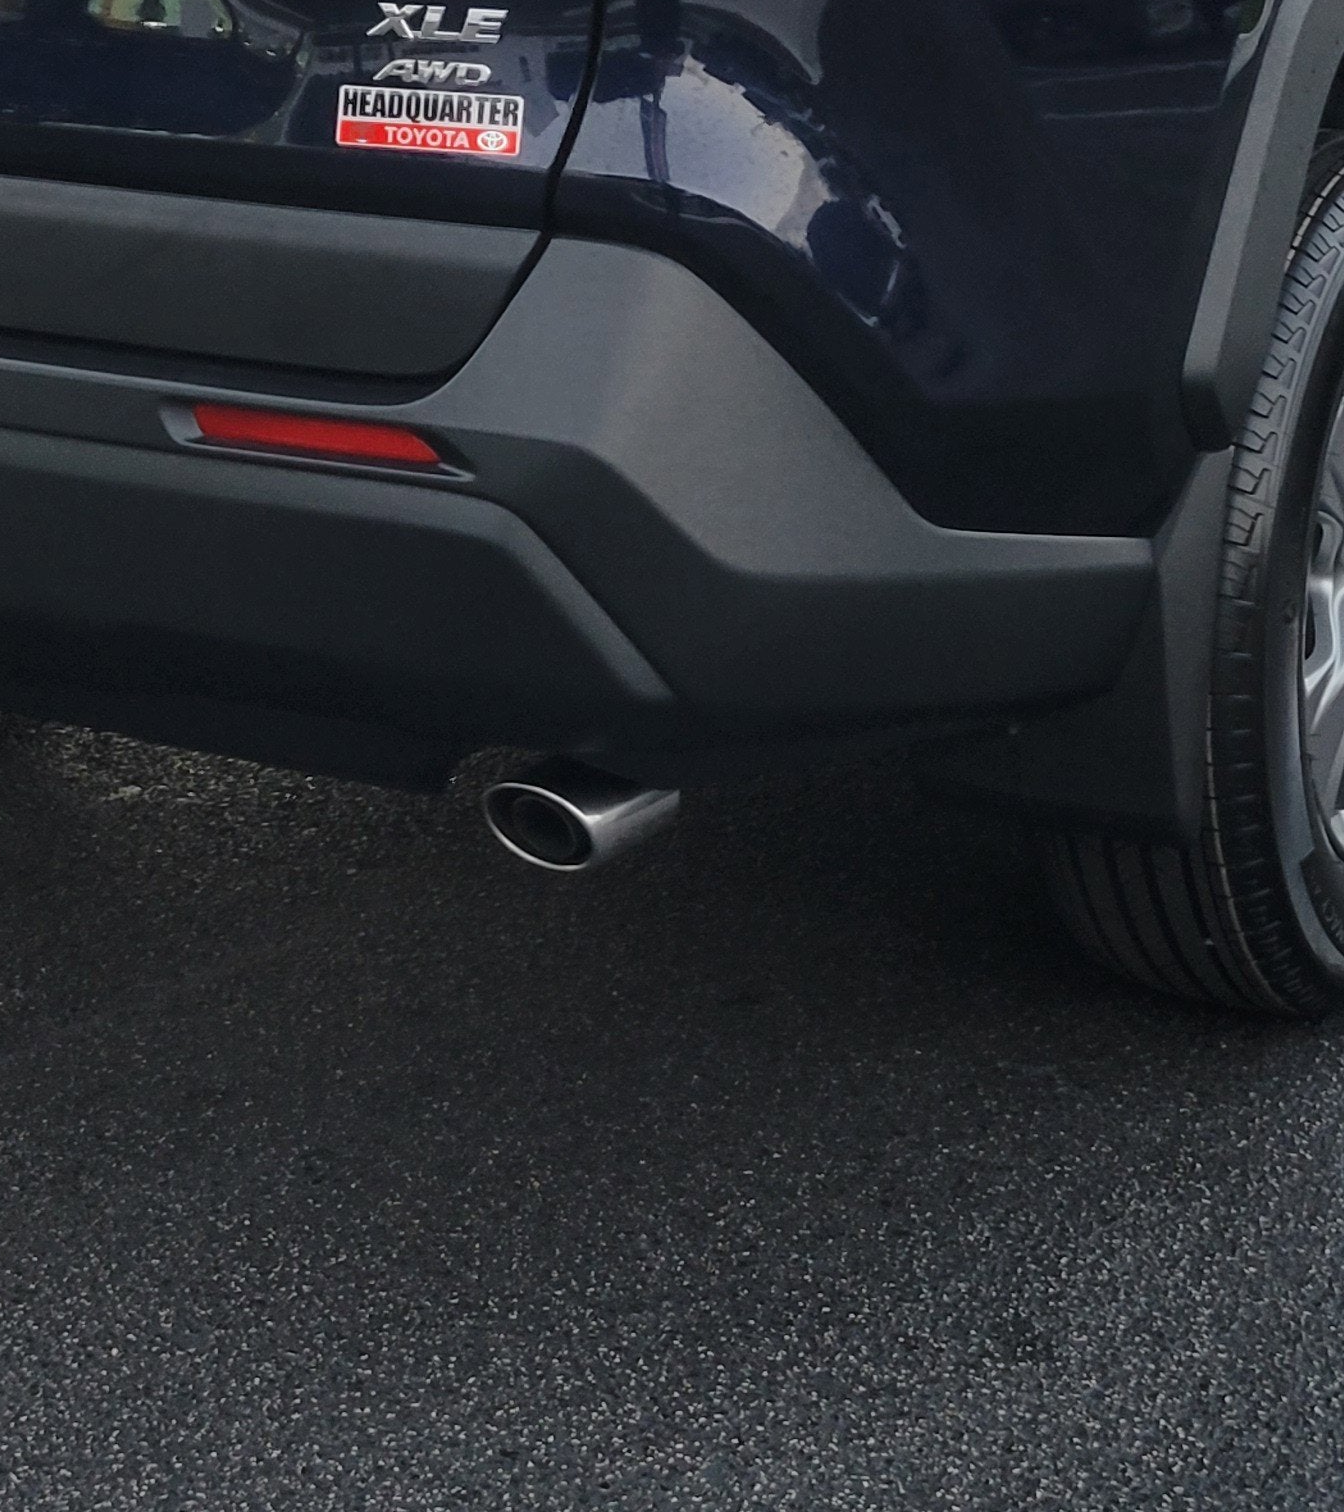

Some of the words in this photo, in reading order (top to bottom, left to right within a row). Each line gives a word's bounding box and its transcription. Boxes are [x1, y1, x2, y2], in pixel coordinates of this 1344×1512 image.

[366, 2, 509, 44] XLE
[372, 58, 492, 87] AWD
[343, 88, 520, 127] HEADQUARTER
[384, 125, 470, 149] TOYOTA
